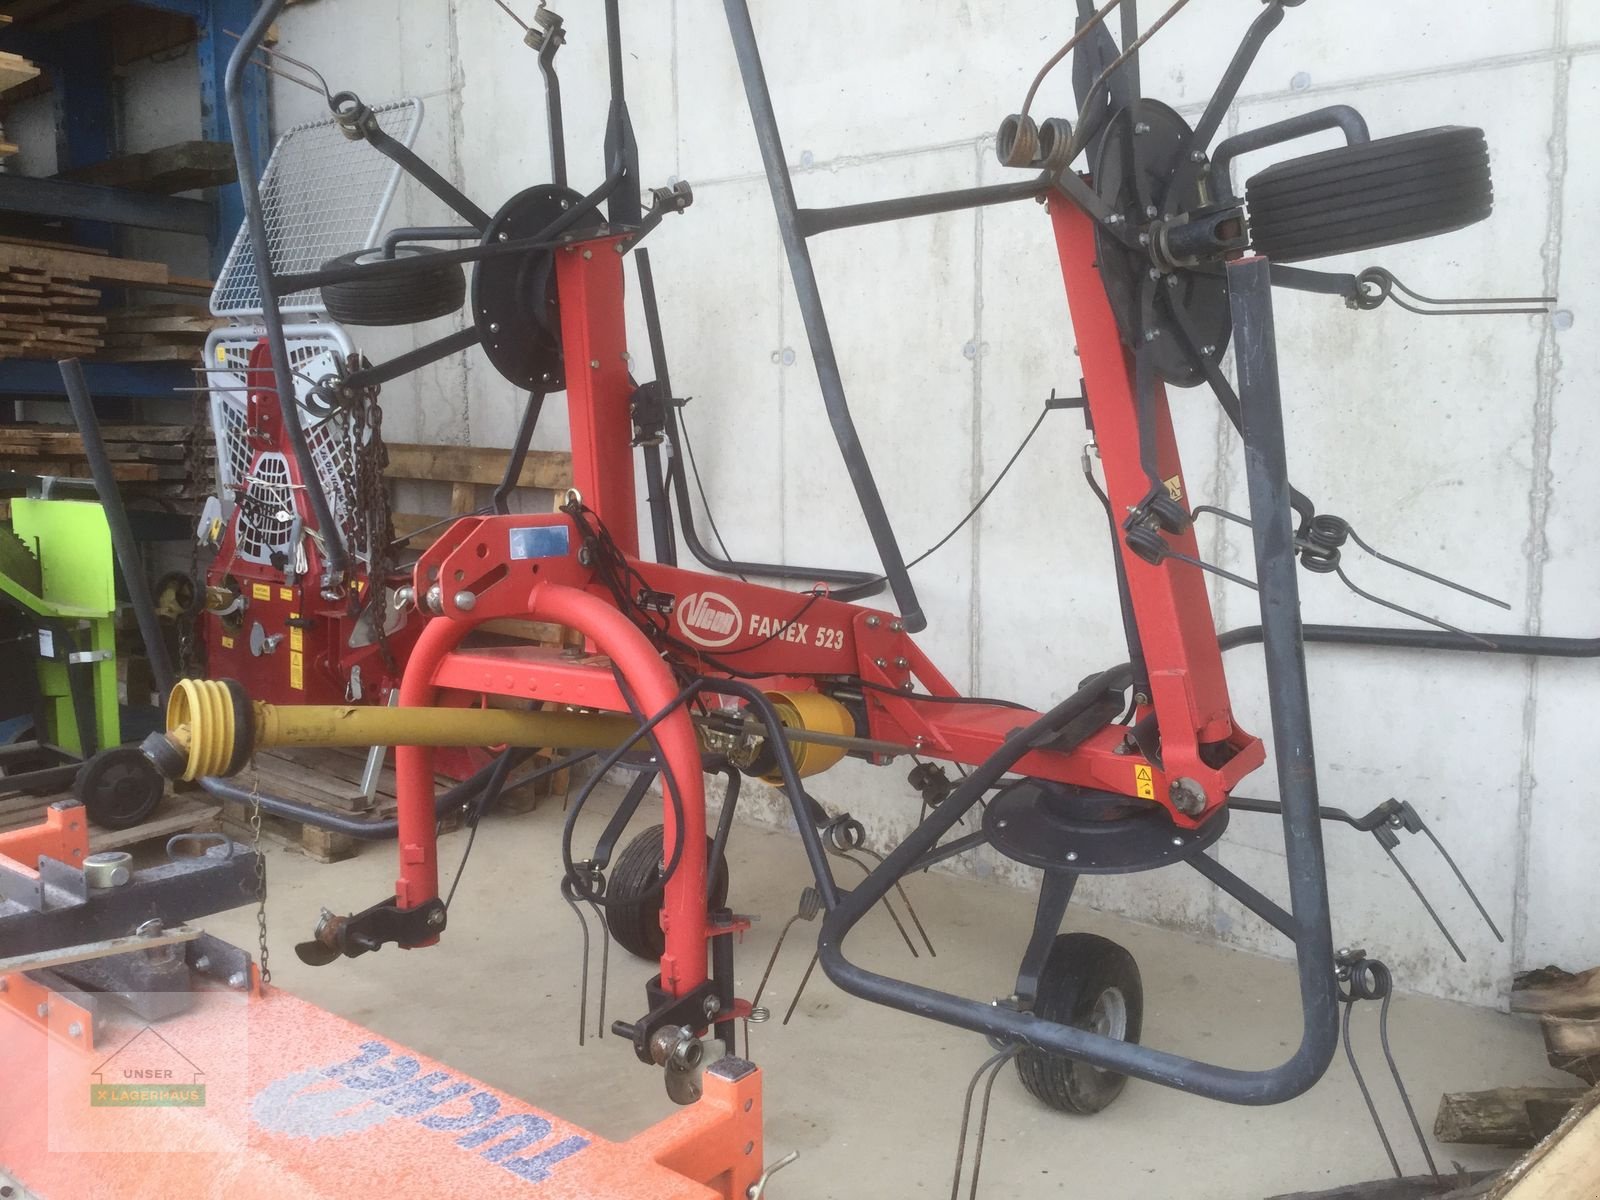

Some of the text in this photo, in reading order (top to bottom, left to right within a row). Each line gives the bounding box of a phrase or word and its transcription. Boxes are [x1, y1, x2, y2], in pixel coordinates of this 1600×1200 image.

[684, 593, 737, 636] Vicon
[748, 614, 845, 650] FANEX 523
